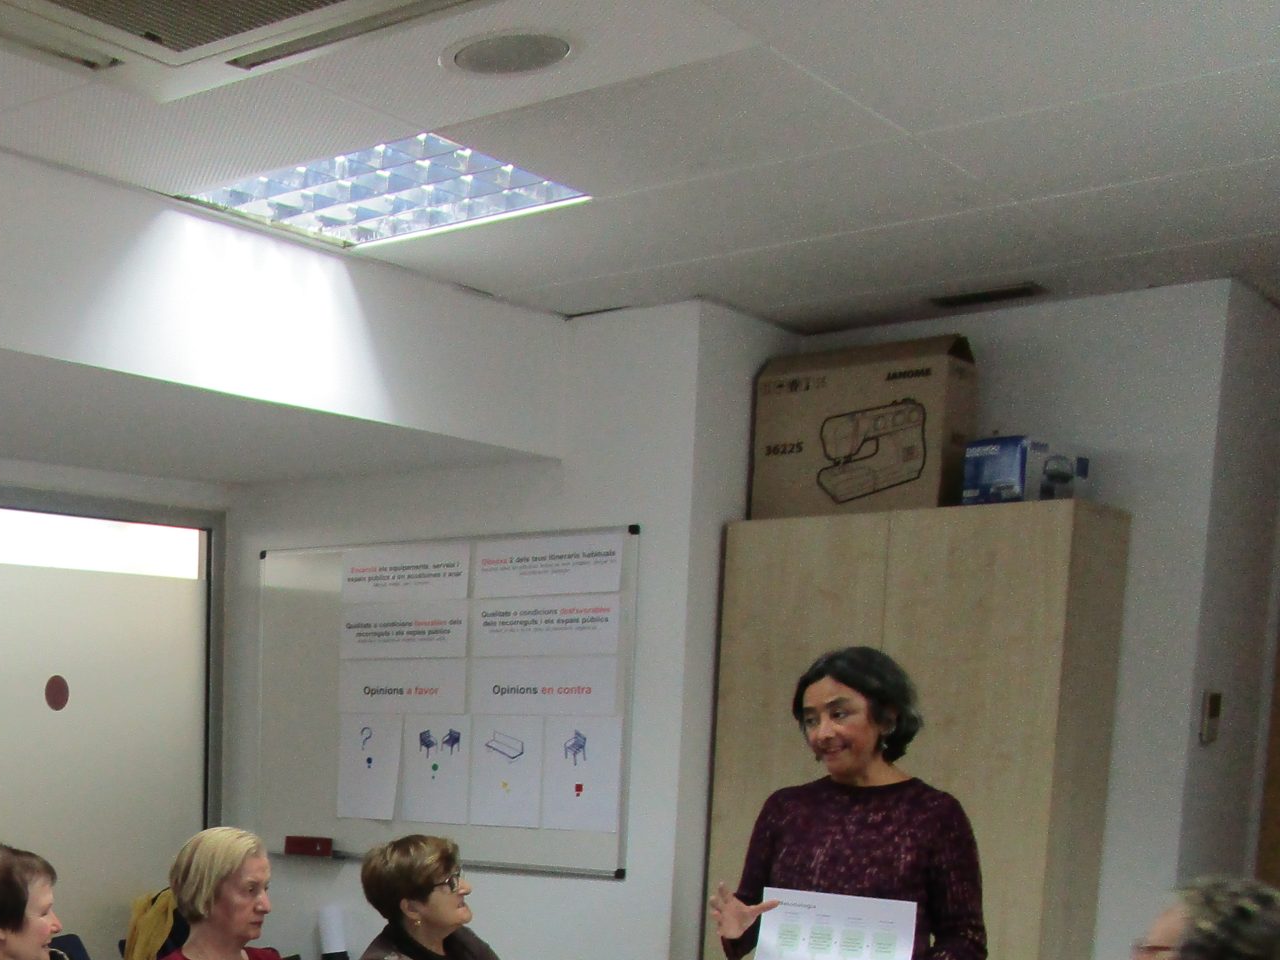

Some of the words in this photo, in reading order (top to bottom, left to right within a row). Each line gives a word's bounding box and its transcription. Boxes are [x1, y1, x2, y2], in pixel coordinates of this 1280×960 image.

[885, 367, 932, 382] JANOME
[764, 442, 804, 457] 36225
[481, 610, 512, 618] Qualitats
[518, 608, 558, 616] condicions
[363, 686, 404, 697] Opinions
[406, 687, 412, 696] a
[414, 686, 440, 696] favor
[492, 684, 538, 697] Opinions
[541, 686, 554, 696] en
[557, 685, 592, 695] contra
